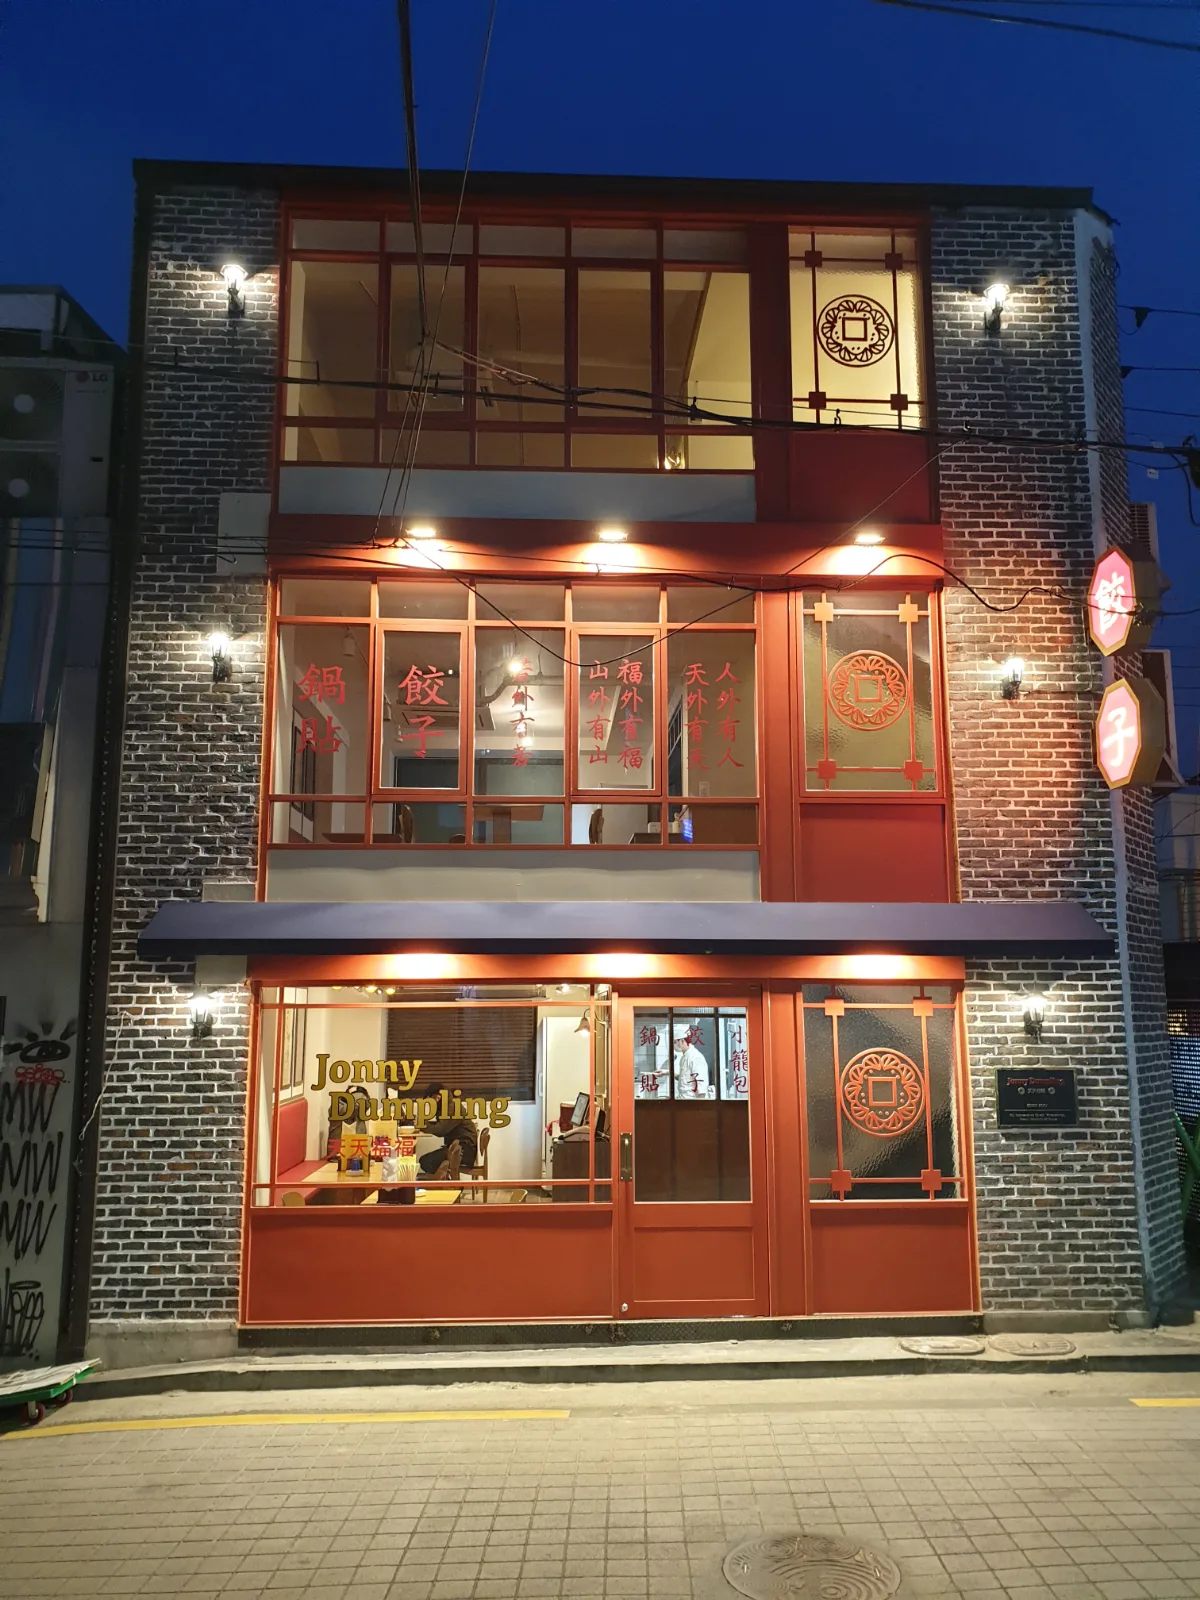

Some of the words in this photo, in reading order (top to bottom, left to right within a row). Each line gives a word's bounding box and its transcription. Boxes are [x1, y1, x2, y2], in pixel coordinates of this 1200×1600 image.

[92, 373, 107, 383] LG
[295, 663, 345, 754] 鍋貼
[398, 665, 447, 757] 餃子
[586, 660, 610, 764] 山外有山
[617, 658, 643, 769] 福外有福
[685, 662, 709, 770] 天外有天
[714, 660, 746, 769] 人外有人
[1102, 706, 1136, 767] 子
[310, 1053, 424, 1091] Jonny
[638, 1024, 661, 1094] 鍋貼
[684, 1025, 706, 1094] 餃子
[328, 1089, 512, 1129] Dumpling
